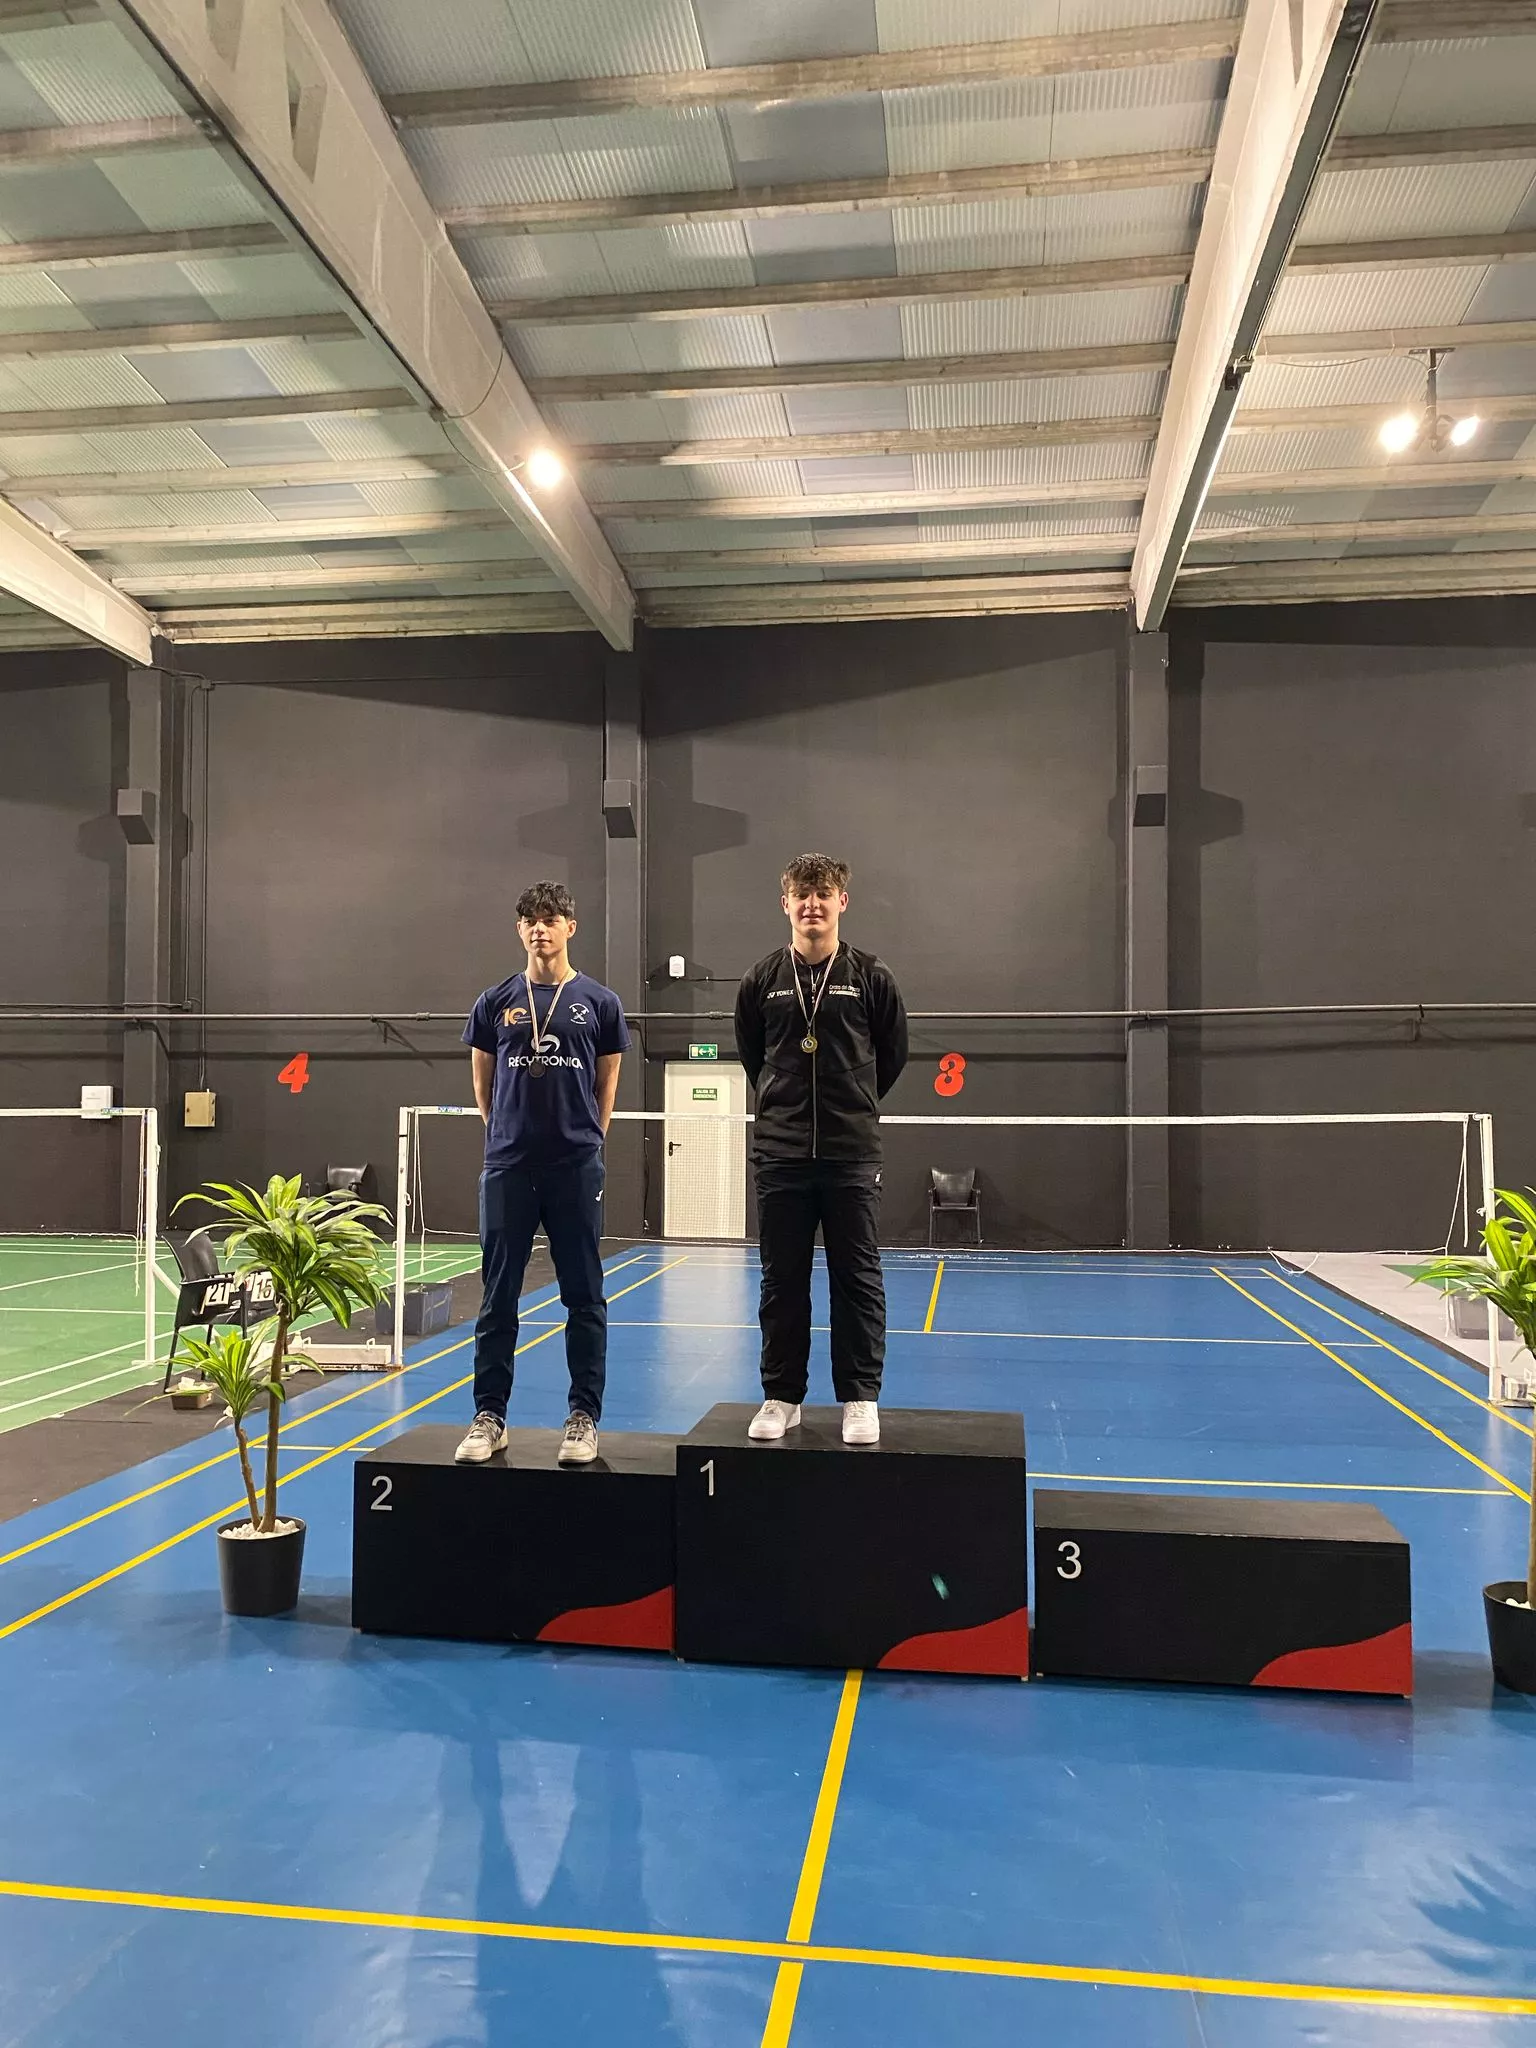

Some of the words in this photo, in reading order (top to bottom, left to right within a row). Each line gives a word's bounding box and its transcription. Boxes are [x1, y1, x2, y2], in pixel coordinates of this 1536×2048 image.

[776, 989, 794, 997] YONEX
[277, 1052, 310, 1094] 4
[934, 1052, 966, 1097] 3
[208, 1282, 226, 1303] 21
[370, 1475, 393, 1511] 2
[700, 1459, 714, 1496] 1
[1056, 1540, 1082, 1579] 3
